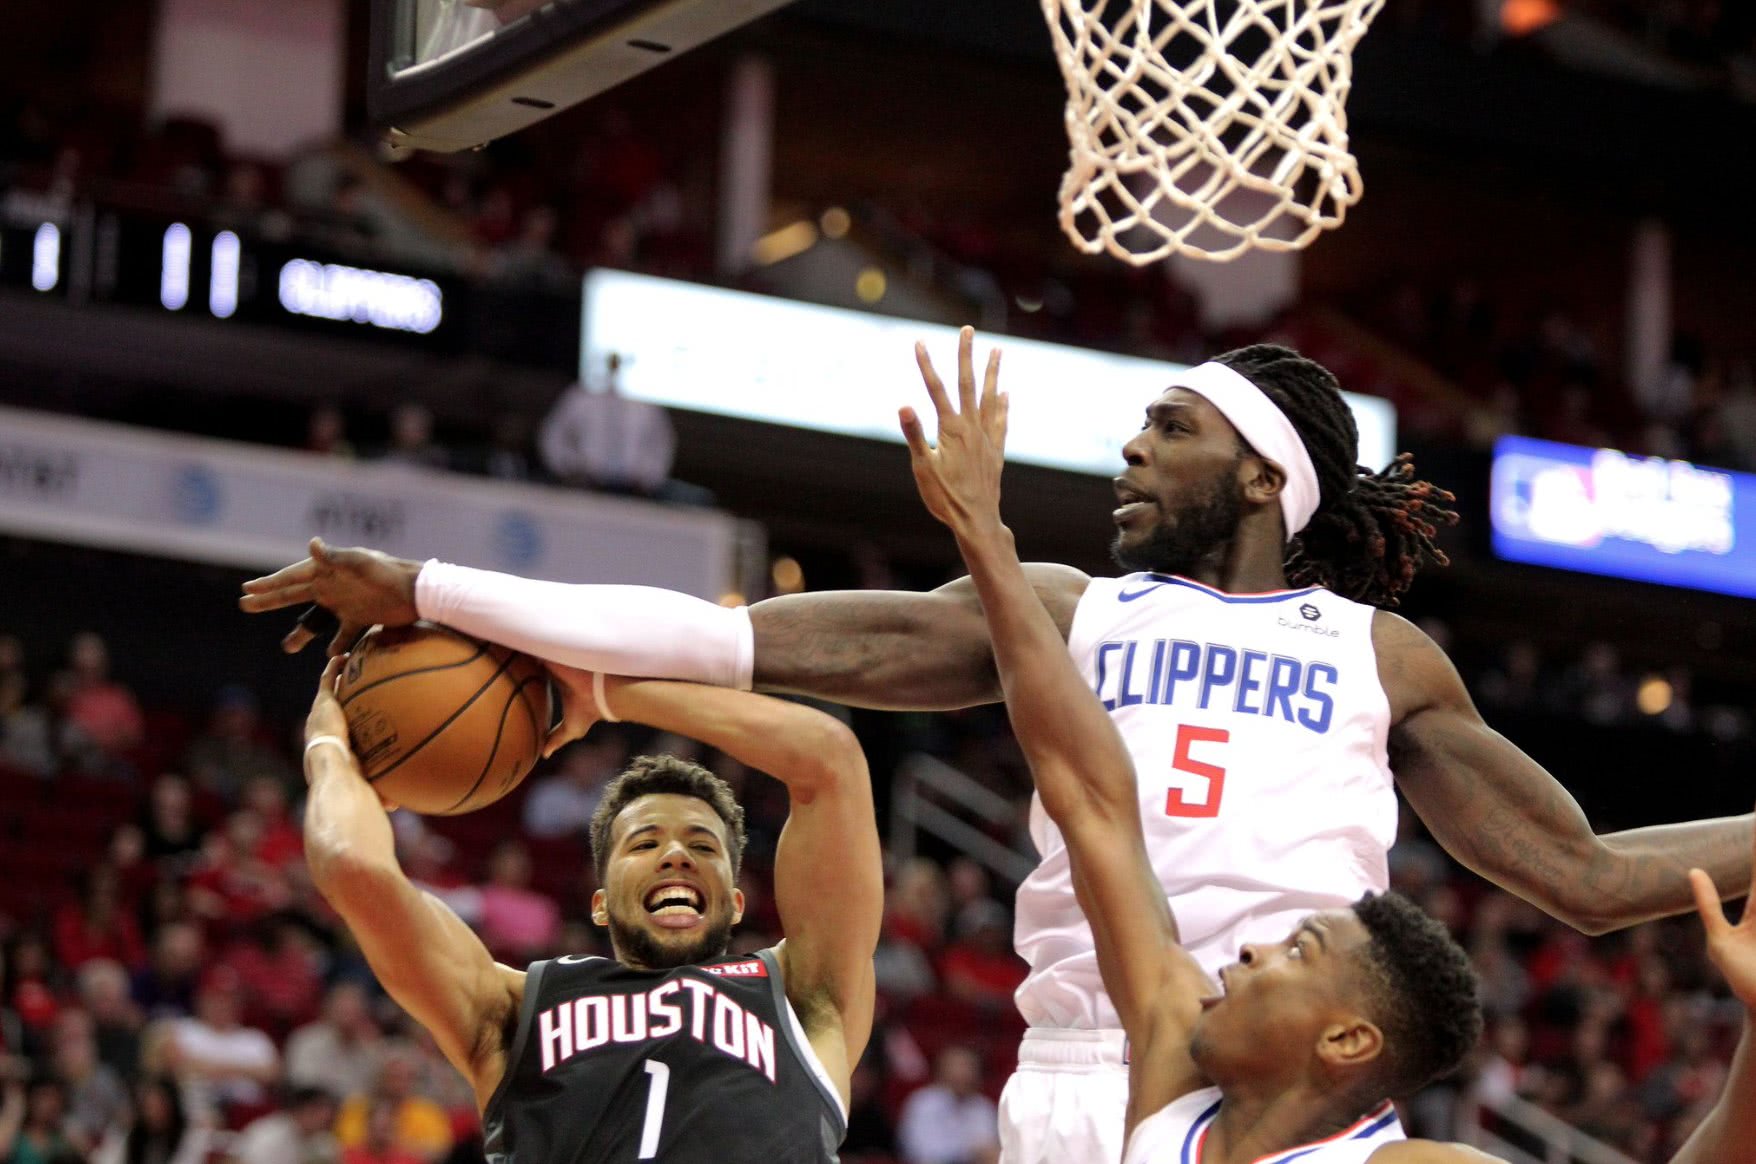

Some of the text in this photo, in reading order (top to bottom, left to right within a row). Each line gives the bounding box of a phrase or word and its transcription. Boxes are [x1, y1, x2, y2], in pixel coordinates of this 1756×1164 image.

[1094, 638, 1339, 735] CLIPPERS
[1165, 723, 1231, 818] 5
[538, 977, 777, 1087] HOUSTON
[637, 1058, 671, 1161] 1
